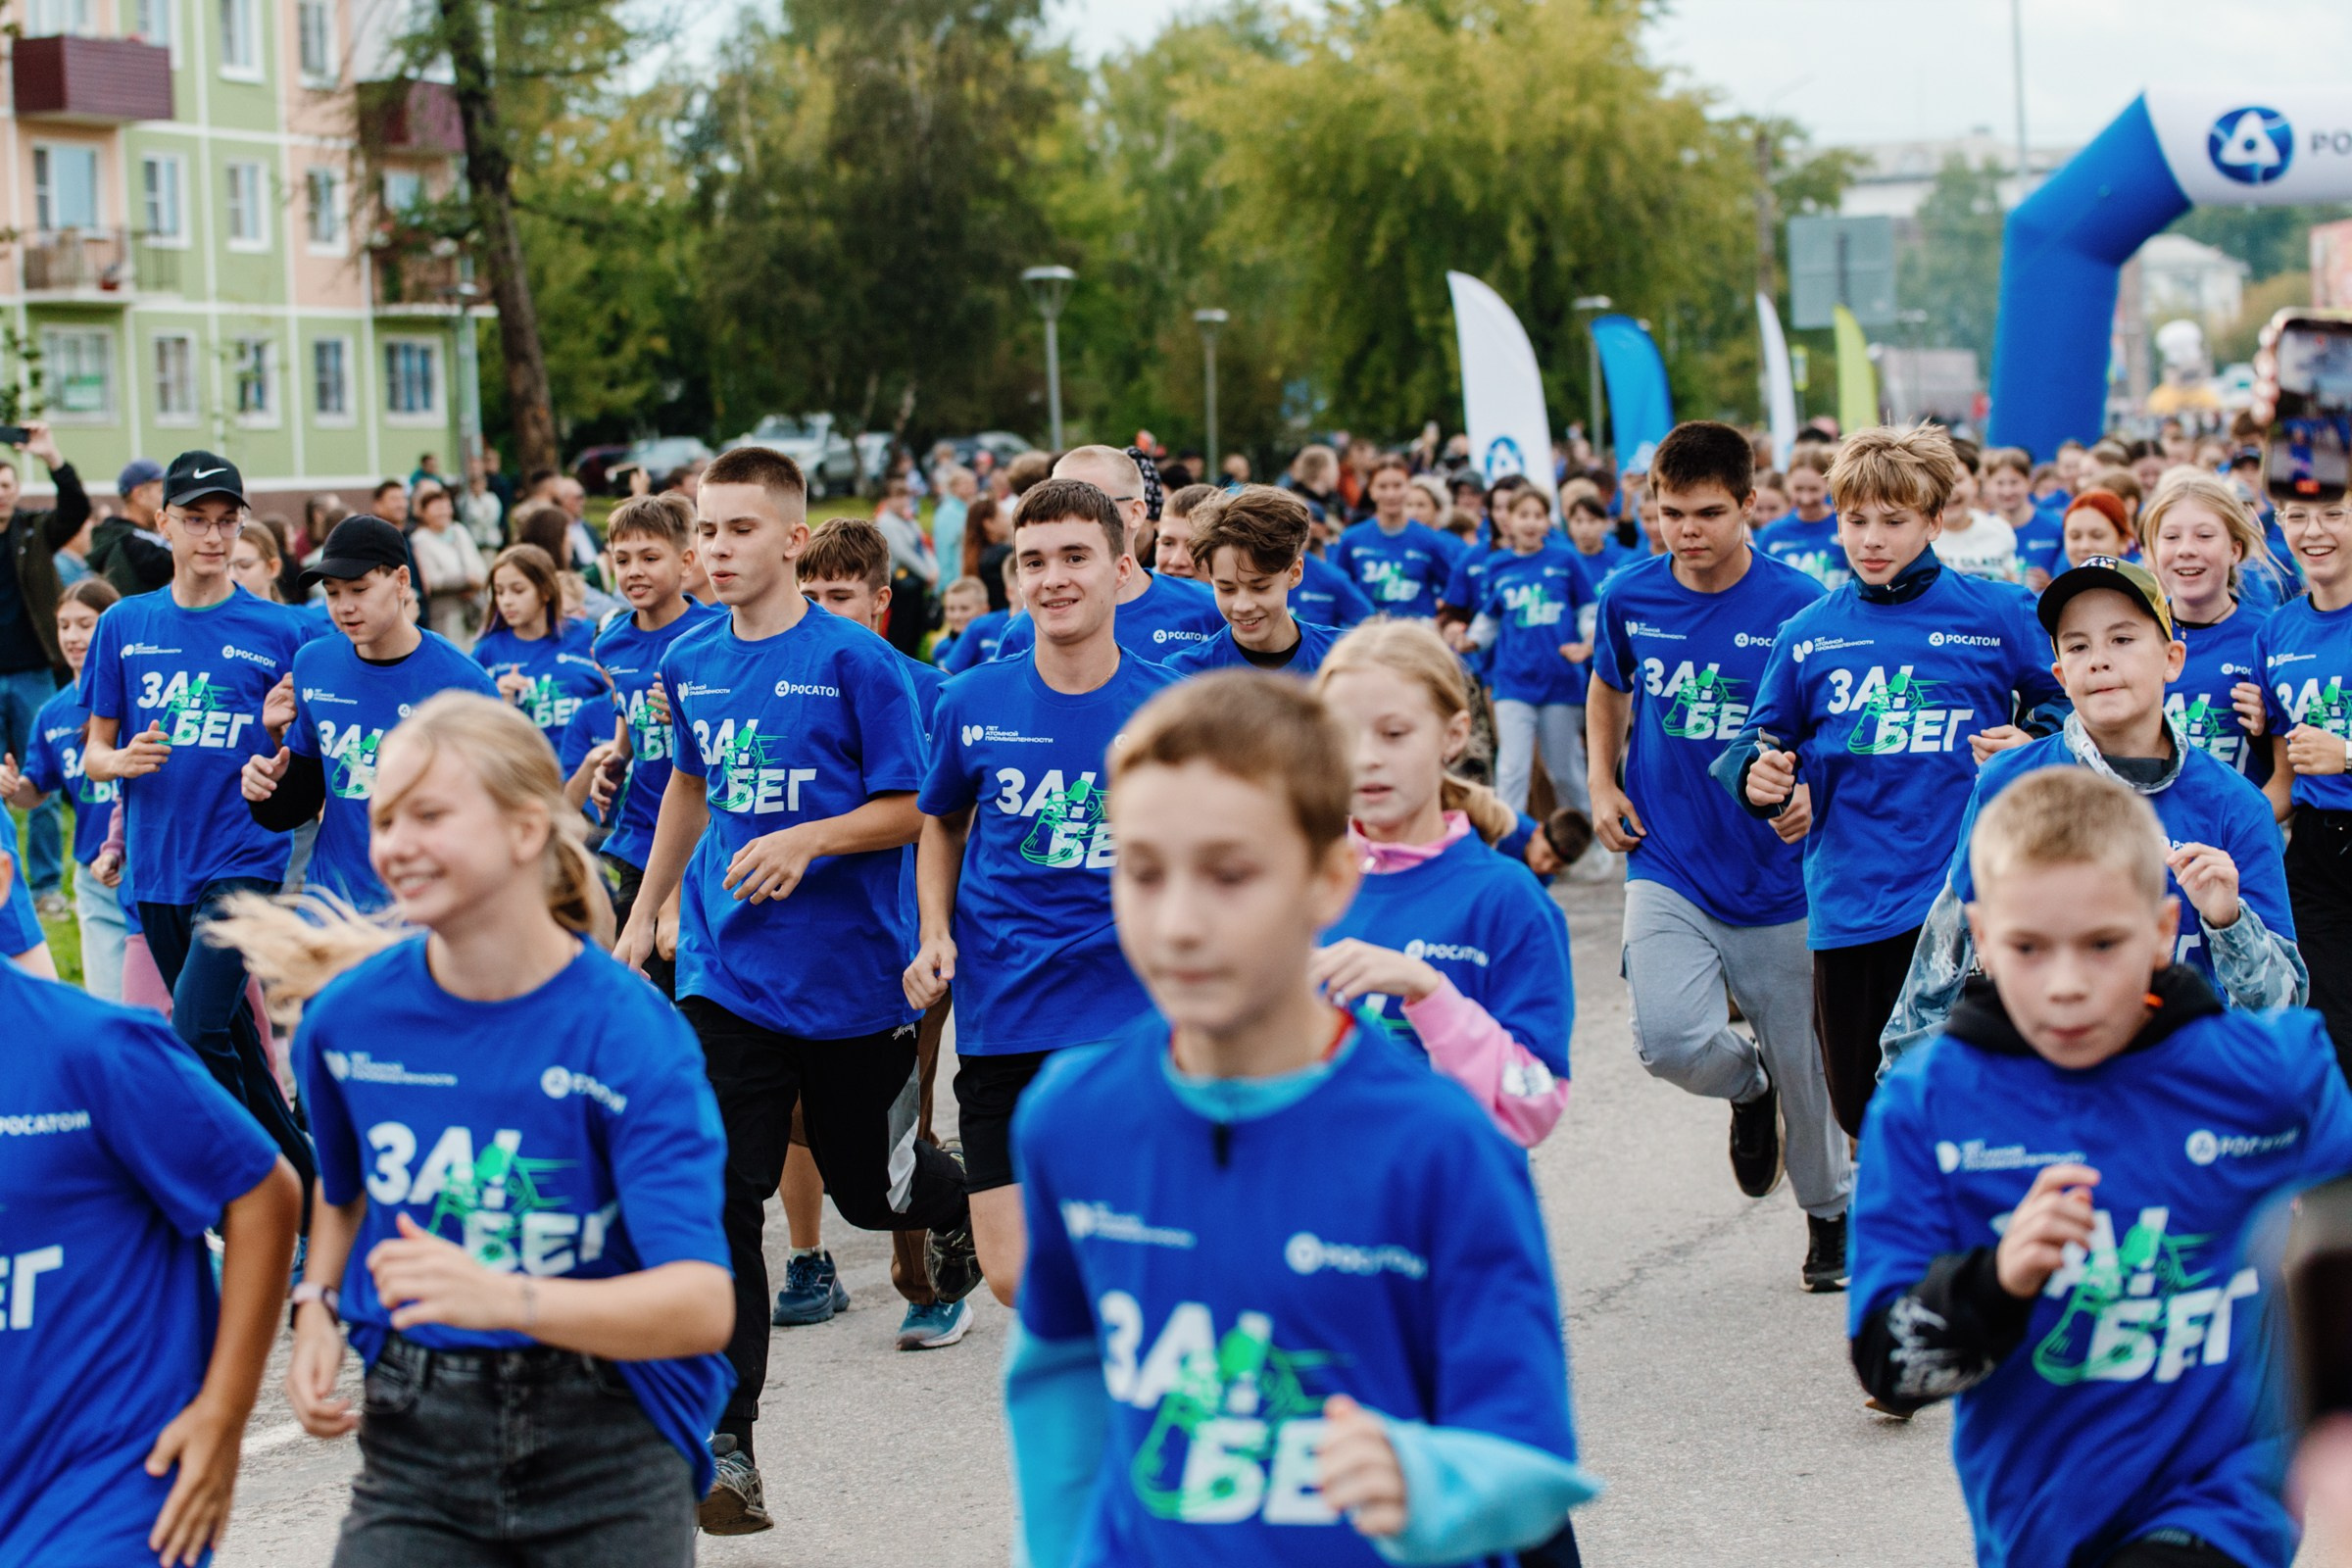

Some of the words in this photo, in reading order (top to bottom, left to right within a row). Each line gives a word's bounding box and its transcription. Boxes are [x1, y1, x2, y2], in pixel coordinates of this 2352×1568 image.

[235, 649, 276, 668] РОСАТОМ
[1946, 634, 2001, 647] РОСАТОМ
[137, 671, 211, 709] ЗА!
[1643, 658, 1720, 701] ЗА!
[1827, 665, 1914, 714] ЗА!
[171, 710, 255, 749] БЕГ
[318, 720, 384, 764] ЗА!
[693, 718, 760, 766] ЗА!
[1873, 709, 1975, 756] БЕГ
[727, 768, 817, 813] БЕГ
[995, 767, 1097, 819] ЗА!
[366, 1121, 522, 1210] ЗА!
[462, 1200, 619, 1278] БЕГ
[2083, 1268, 2259, 1383] БЕГ
[1099, 1290, 1273, 1416] ЗА!
